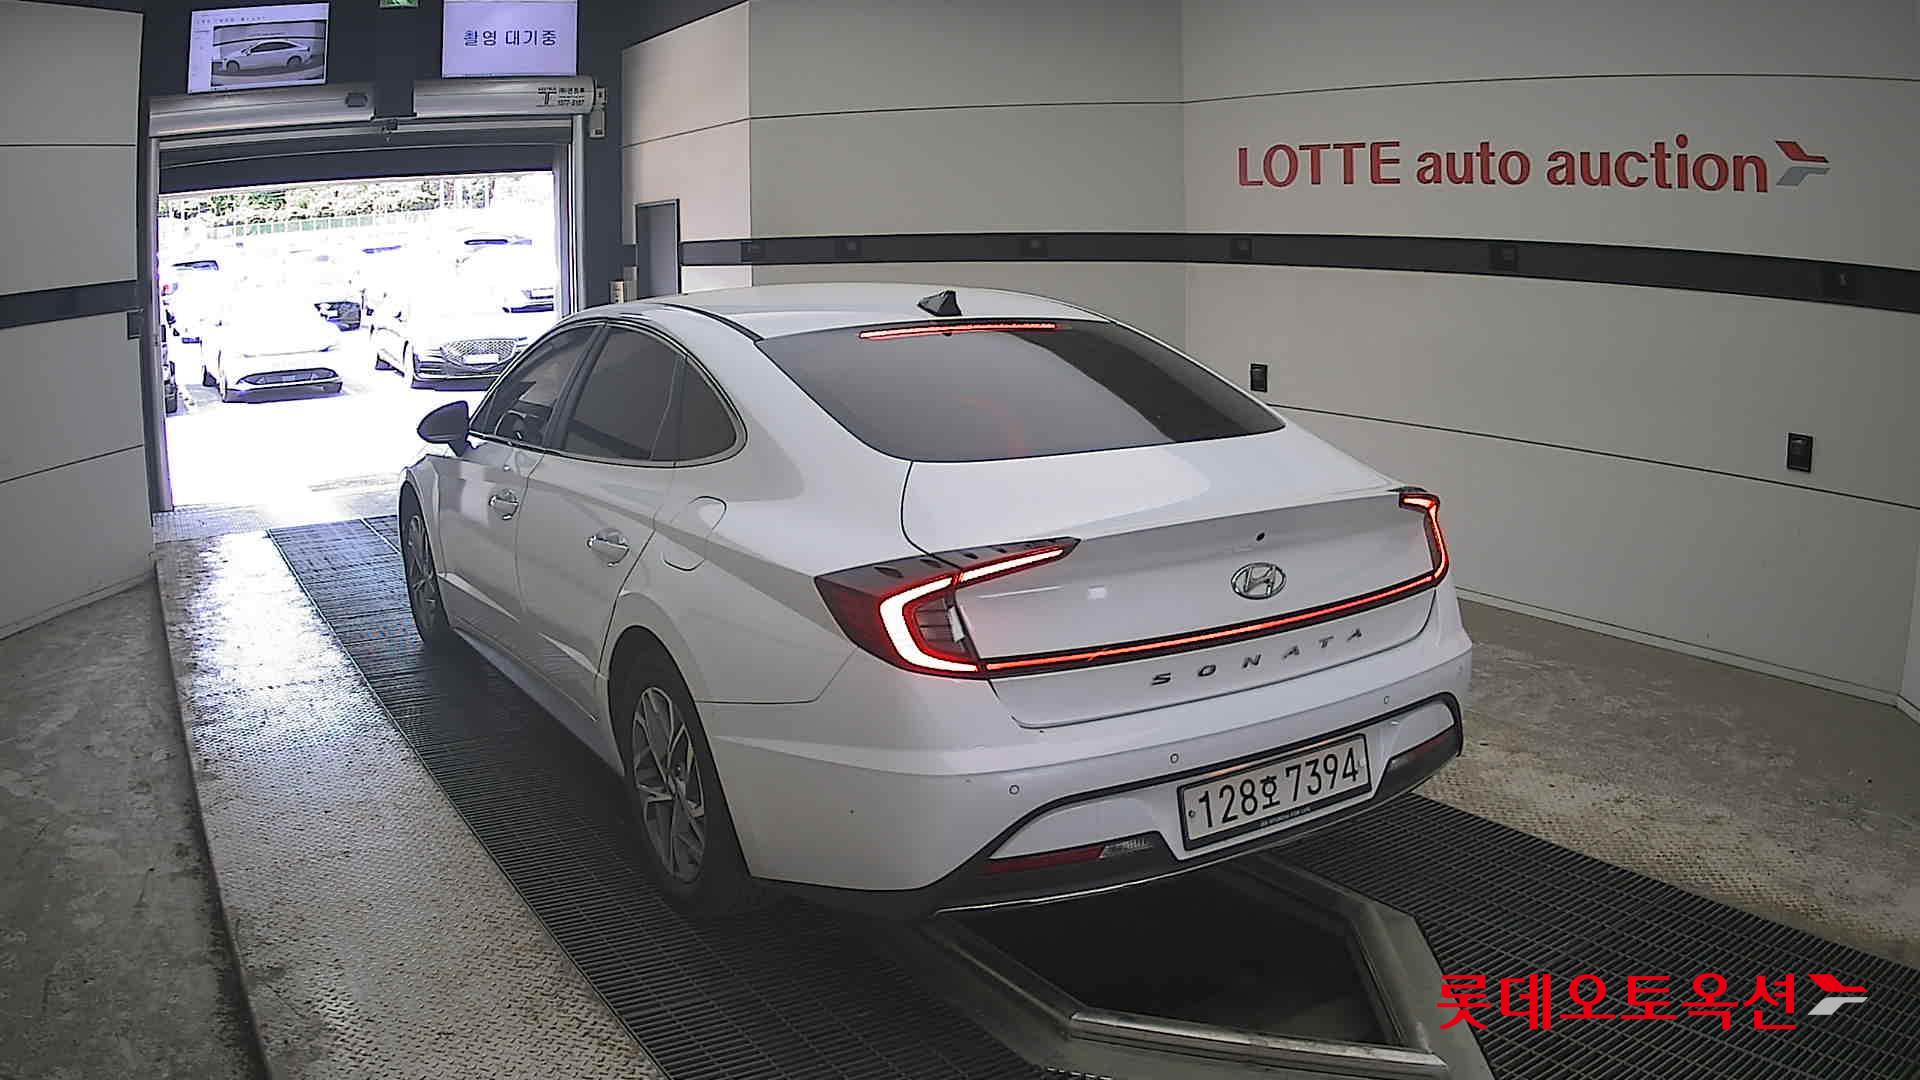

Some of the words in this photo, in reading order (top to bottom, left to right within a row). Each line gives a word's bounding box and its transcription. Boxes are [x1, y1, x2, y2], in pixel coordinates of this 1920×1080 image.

[463, 30, 497, 46] 촬영
[505, 29, 557, 46] 대기중
[1238, 141, 1400, 187] LOTTE
[1417, 141, 1530, 185] auto
[1547, 134, 1768, 193] auction
[1151, 628, 1363, 686] SONATA
[1198, 775, 1281, 828] 128호
[1285, 747, 1359, 802] 7394
